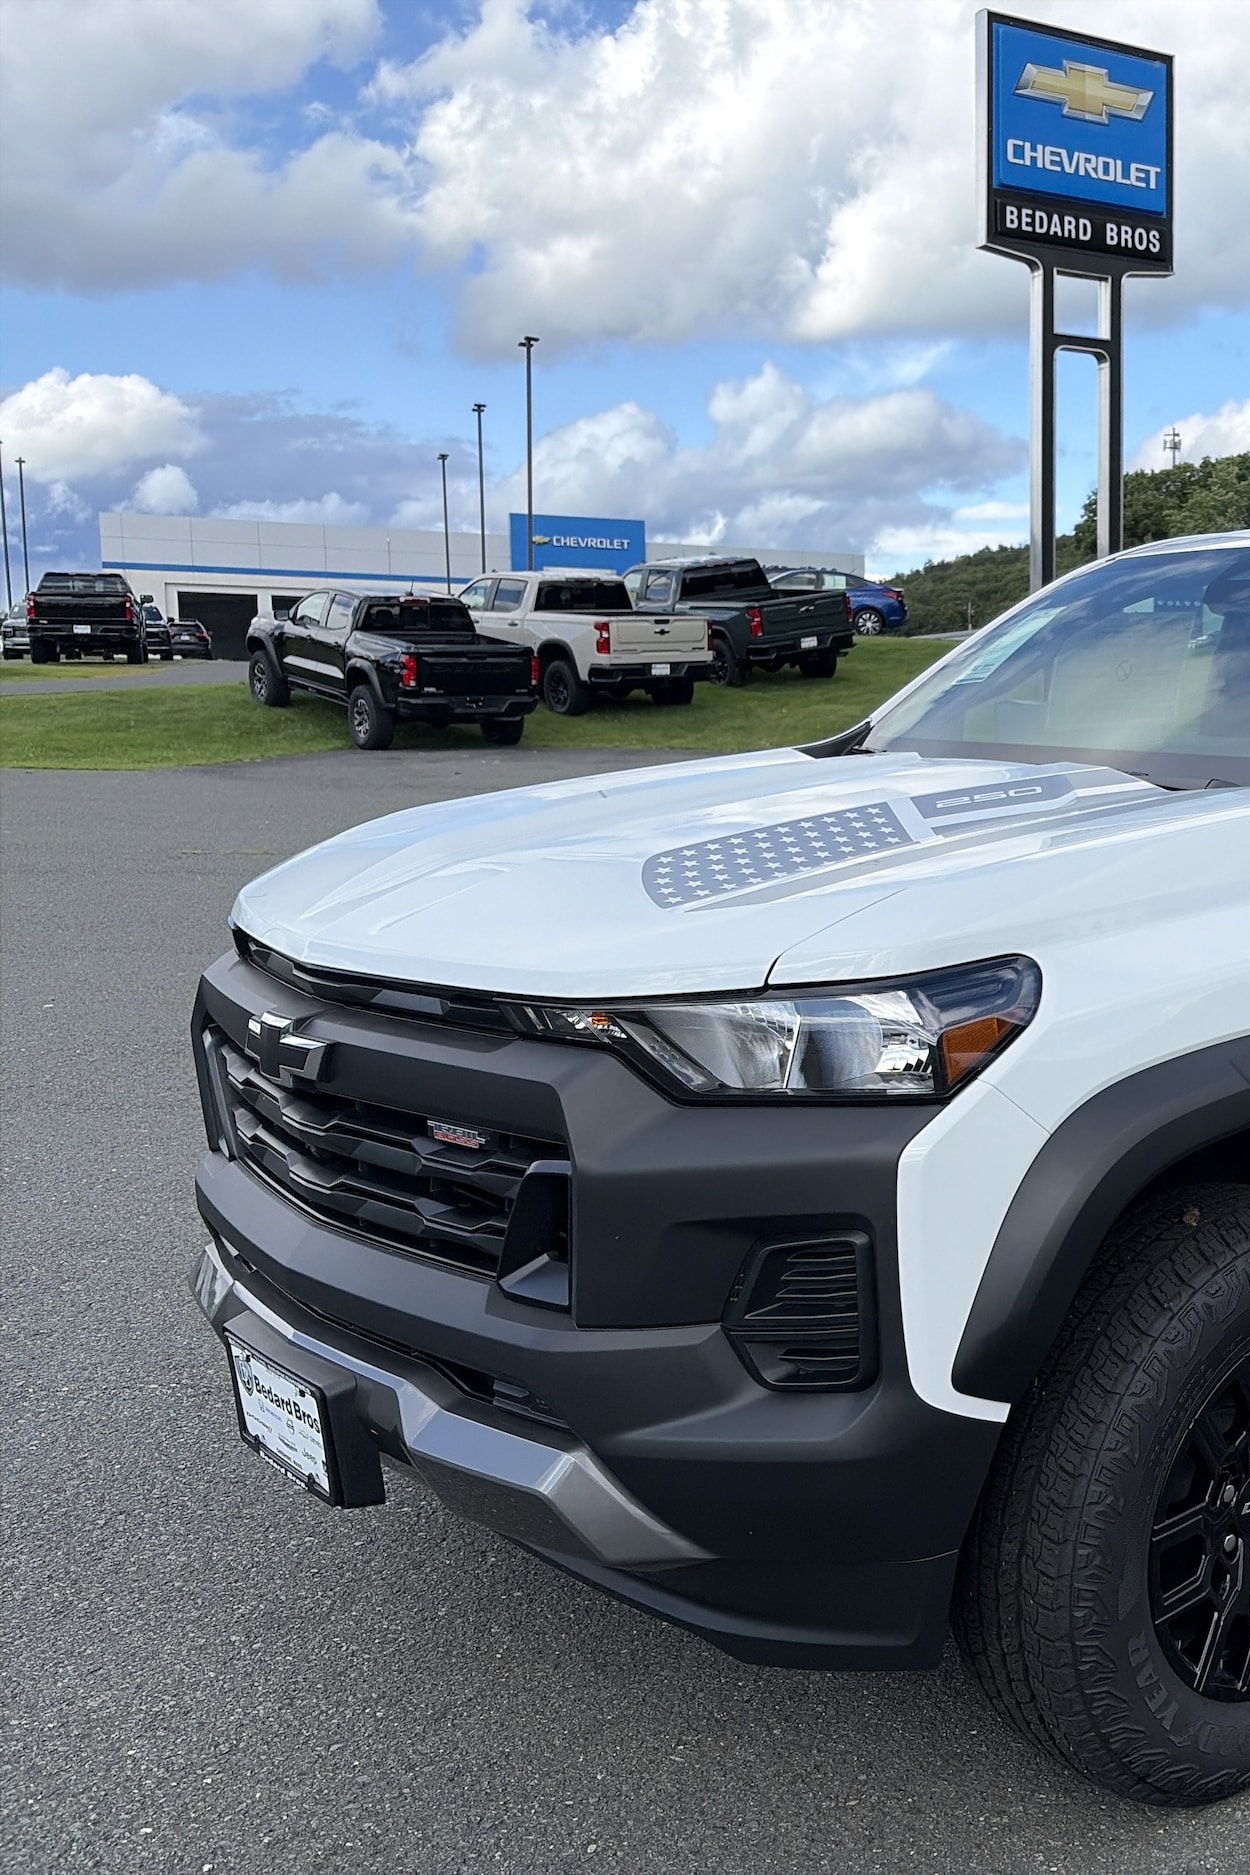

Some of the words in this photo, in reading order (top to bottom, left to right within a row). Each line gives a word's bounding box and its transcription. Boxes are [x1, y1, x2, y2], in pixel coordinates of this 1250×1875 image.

[1006, 138, 1161, 190] CHEVROLET
[1005, 205, 1092, 241] BEDARD
[1105, 223, 1161, 253] BROS
[552, 535, 631, 550] CHEVROLET
[936, 786, 1043, 809] 250
